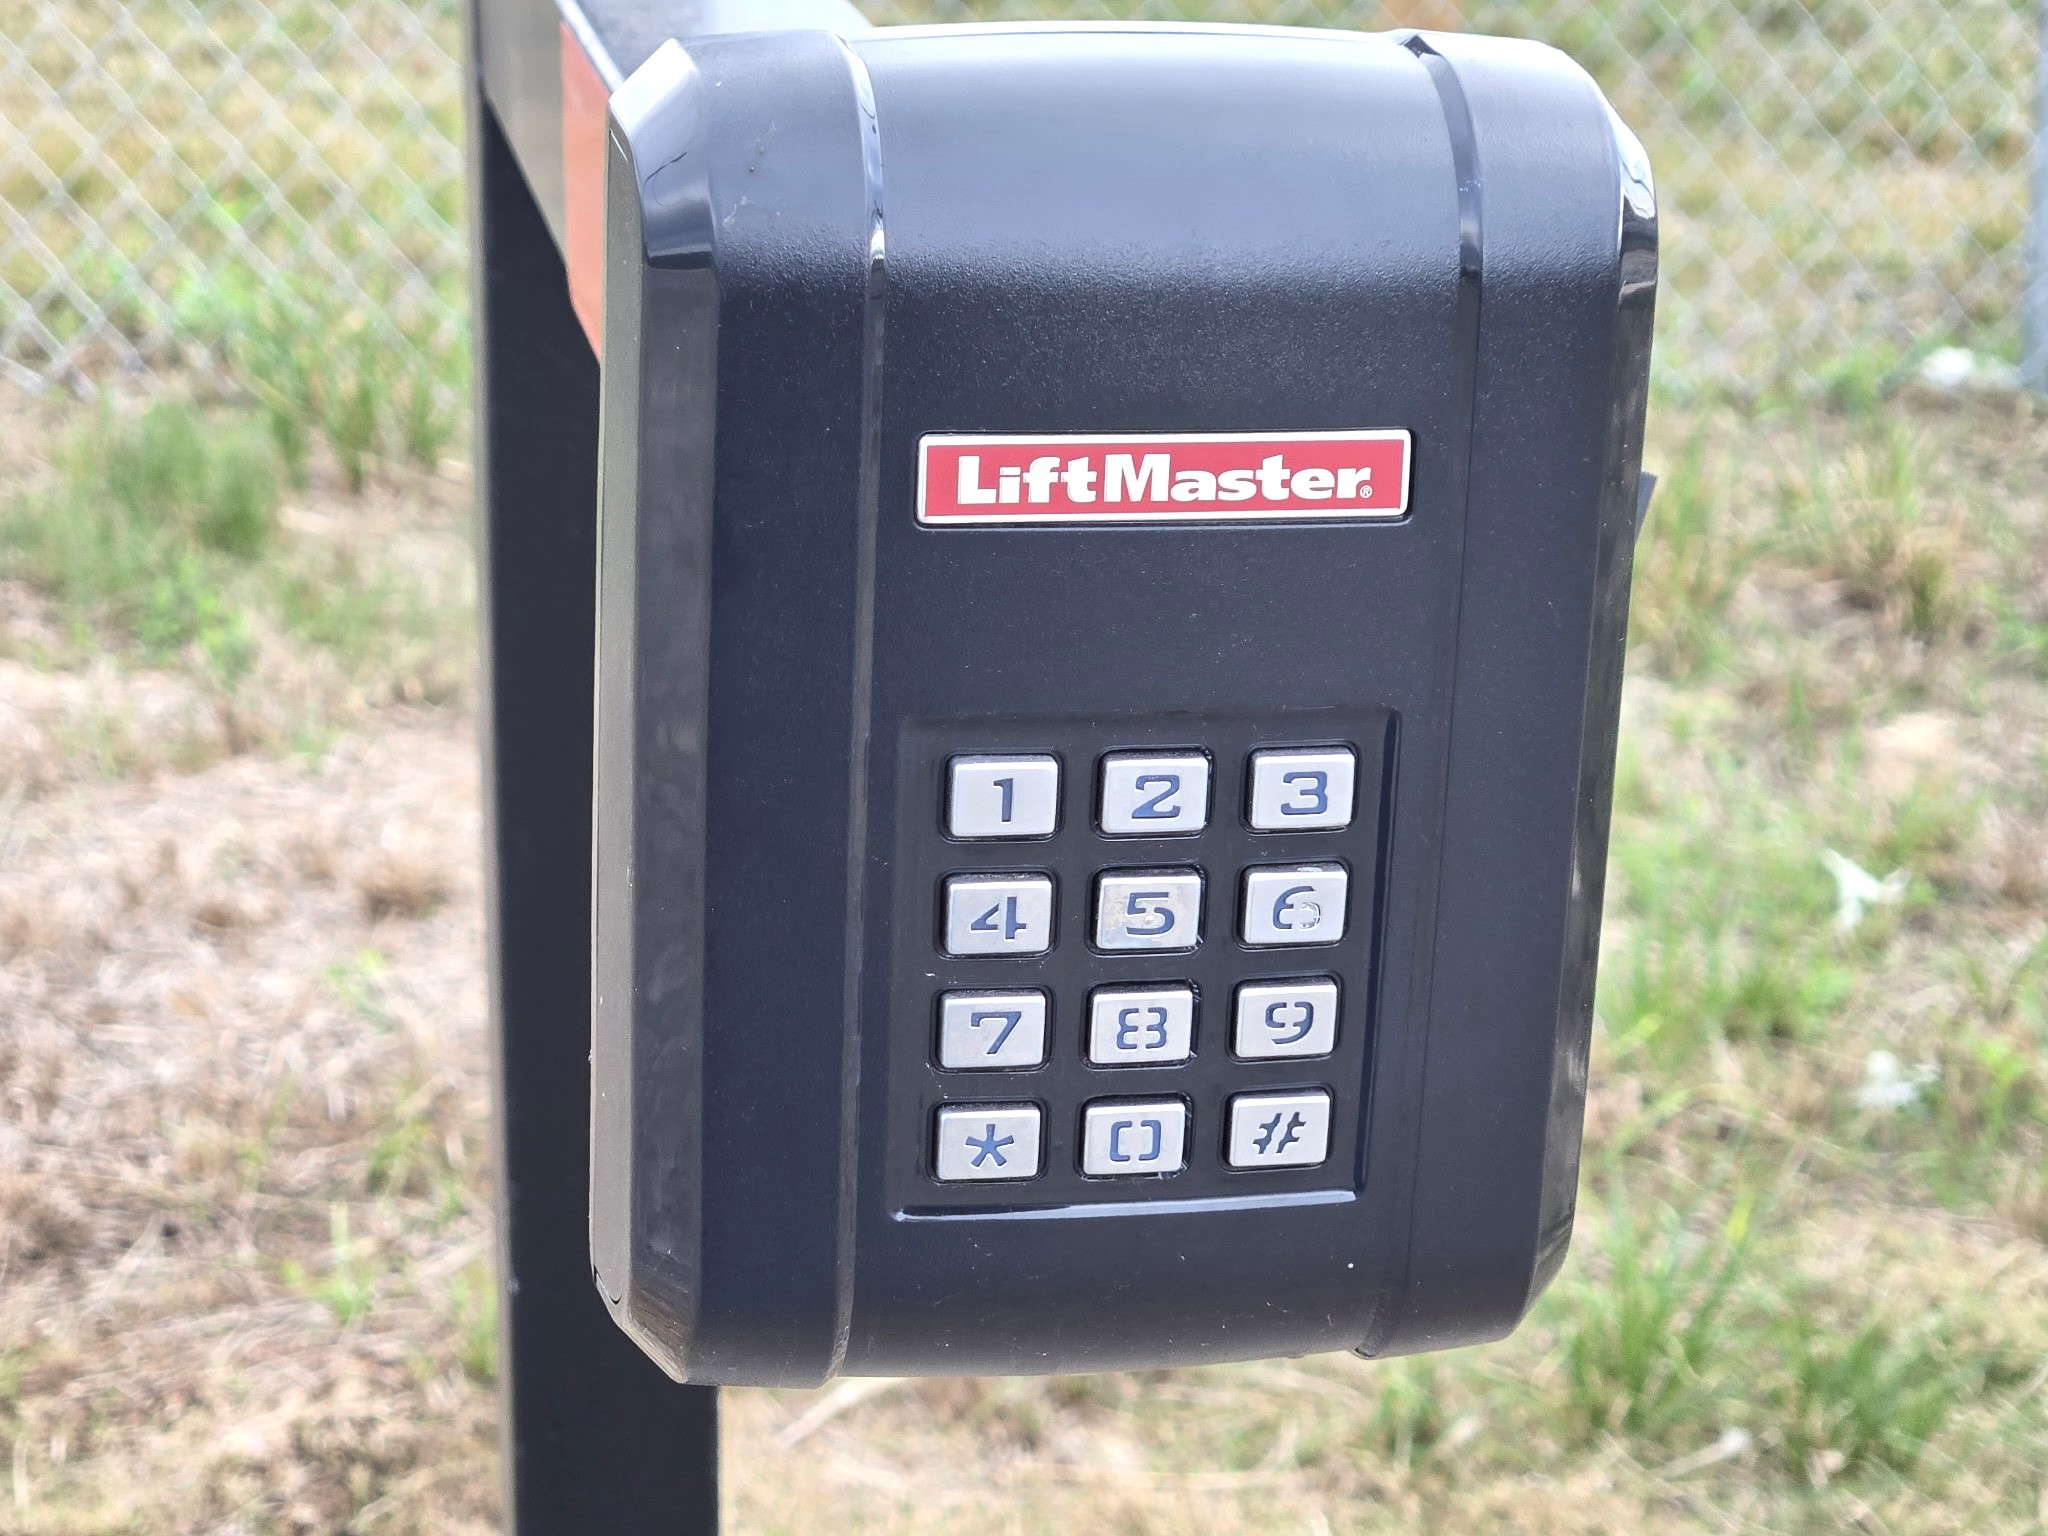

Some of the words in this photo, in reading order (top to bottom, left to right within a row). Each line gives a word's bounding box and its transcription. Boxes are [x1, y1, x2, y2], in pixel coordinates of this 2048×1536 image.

[993, 777, 1014, 822] 1
[1131, 774, 1181, 819] 2
[1280, 771, 1328, 815] 3
[970, 896, 1027, 940] 4
[1126, 891, 1175, 936] 5
[1272, 885, 1321, 930] 6
[970, 1011, 1022, 1055] 7
[1116, 1007, 1168, 1050] 8
[1265, 1001, 1314, 1044] 9
[1110, 1120, 1161, 1162] 0
[1252, 1112, 1306, 1155] #
